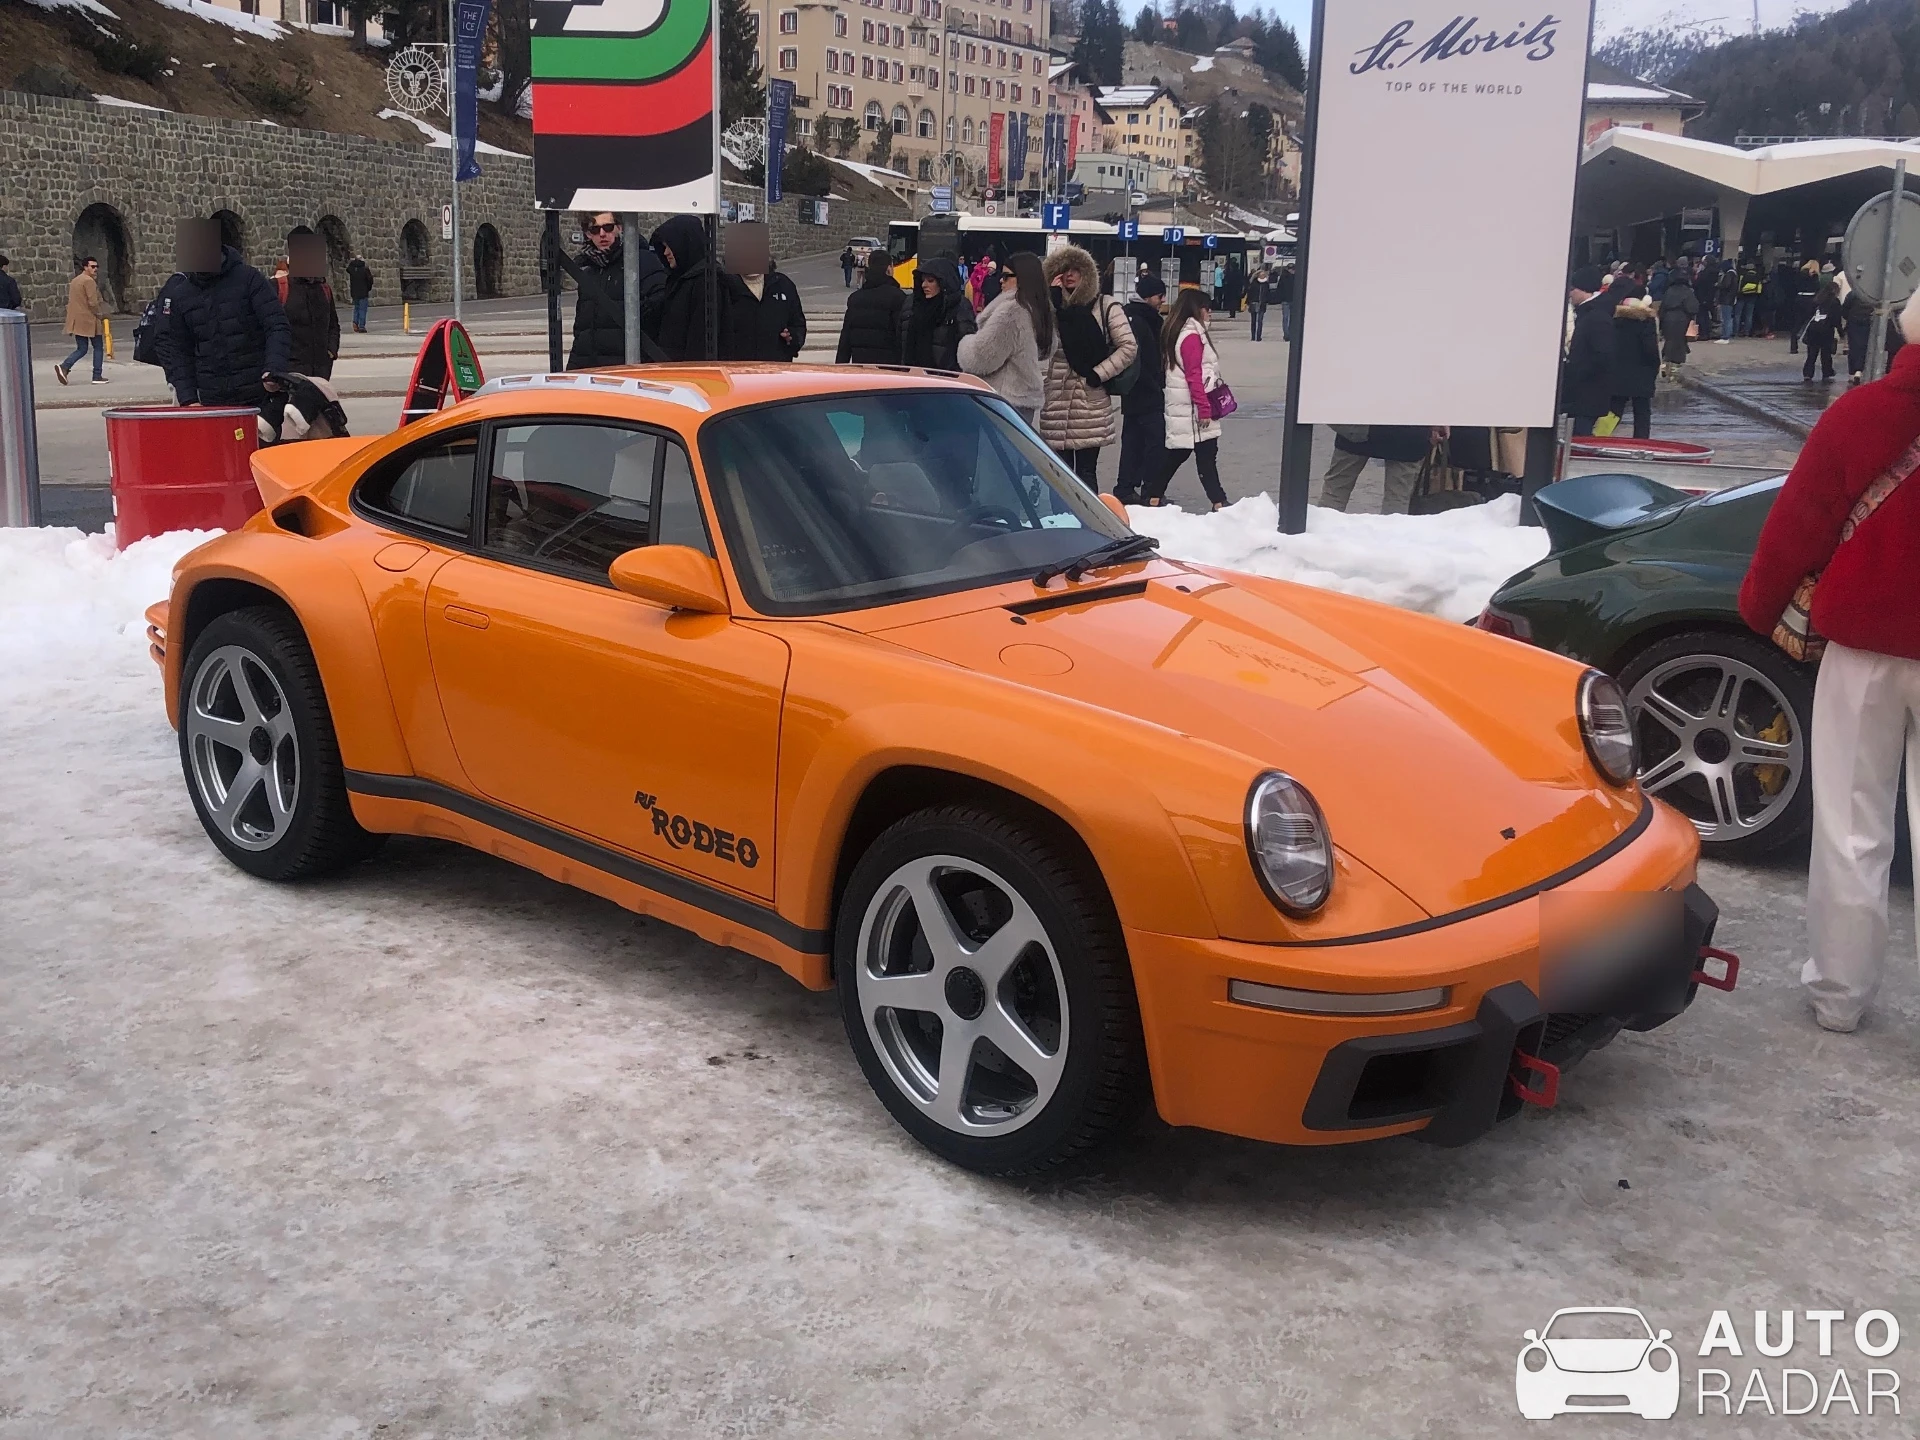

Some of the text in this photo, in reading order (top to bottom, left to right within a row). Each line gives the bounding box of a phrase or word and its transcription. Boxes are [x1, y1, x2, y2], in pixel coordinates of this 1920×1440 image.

[463, 11, 478, 20] THE
[462, 22, 475, 31] ICE
[1350, 14, 1562, 75] St. Moritz
[1386, 82, 1523, 95] TOP OF THE WORLD
[1052, 206, 1063, 226] F
[1124, 222, 1133, 238] E
[1164, 229, 1170, 242] D
[1172, 229, 1181, 242] D
[1206, 236, 1214, 247] C
[1704, 239, 1714, 253] B
[634, 790, 658, 810] RUF
[651, 806, 760, 869] RODEO
